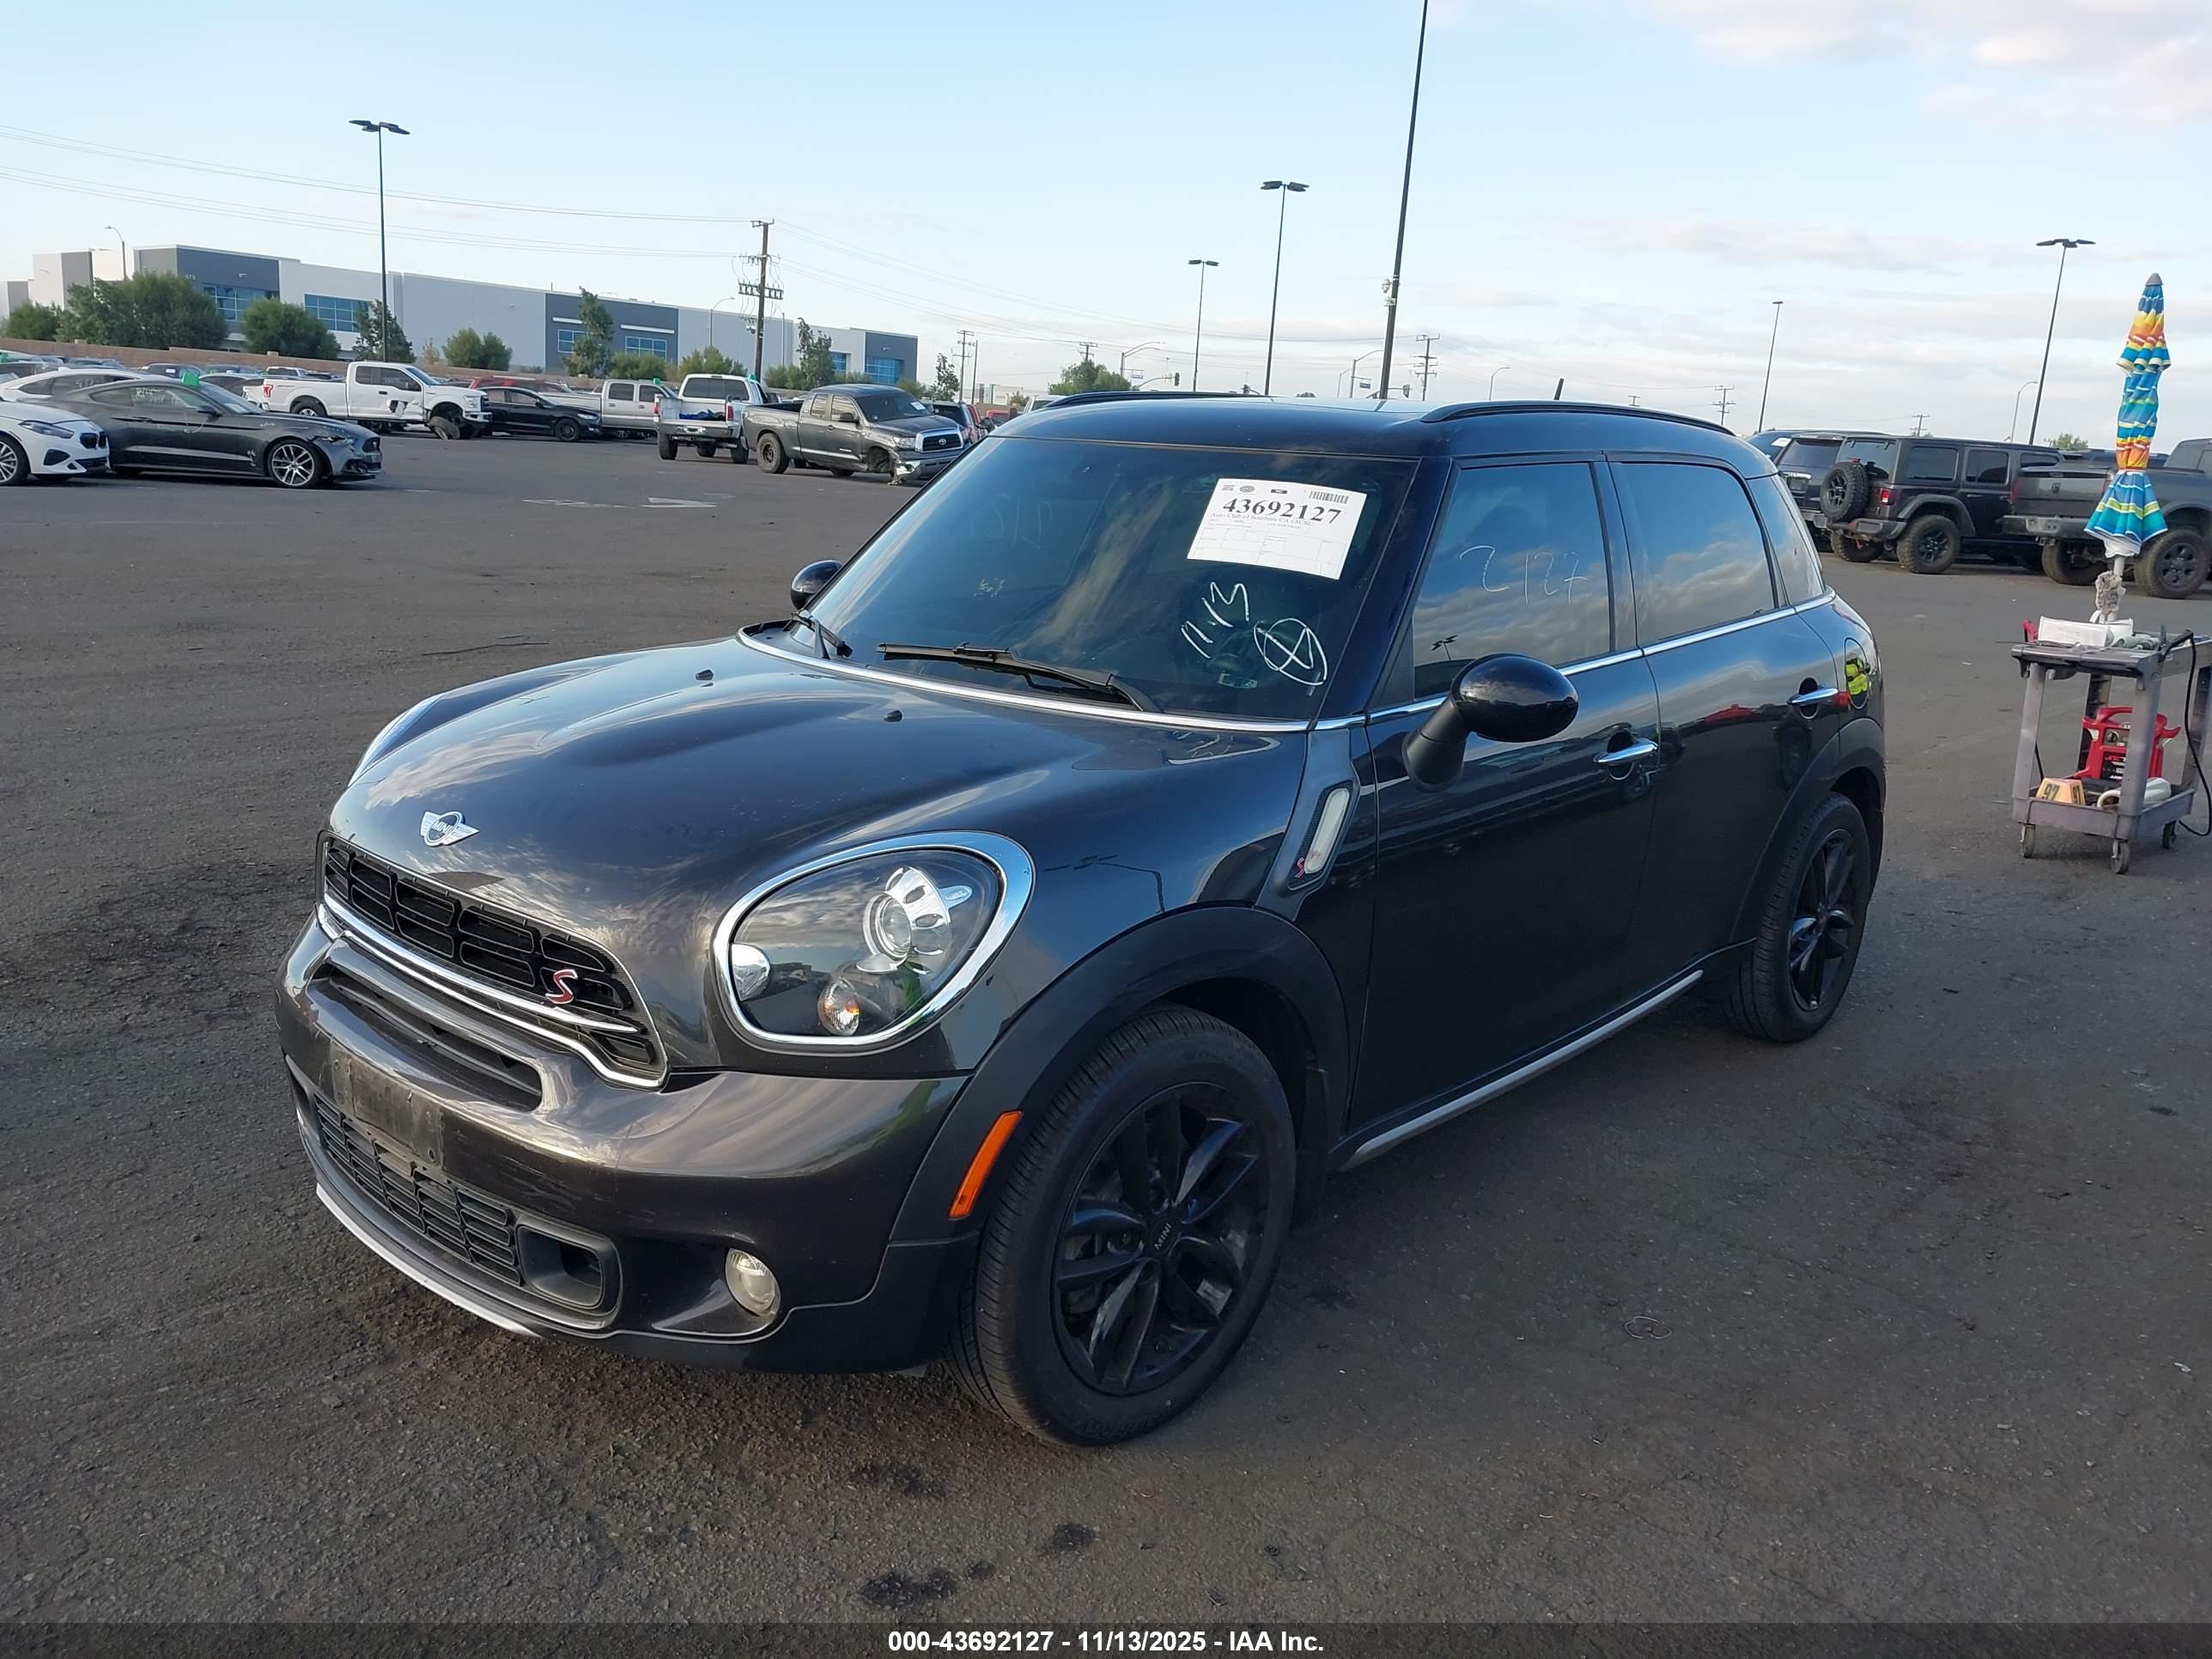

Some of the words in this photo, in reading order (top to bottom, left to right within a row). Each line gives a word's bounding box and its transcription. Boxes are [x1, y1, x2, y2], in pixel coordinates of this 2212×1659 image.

[1223, 498, 1342, 524] 43692127
[431, 820, 454, 835] MINI
[545, 969, 578, 1004] S
[1154, 1223, 1172, 1250] MINI
